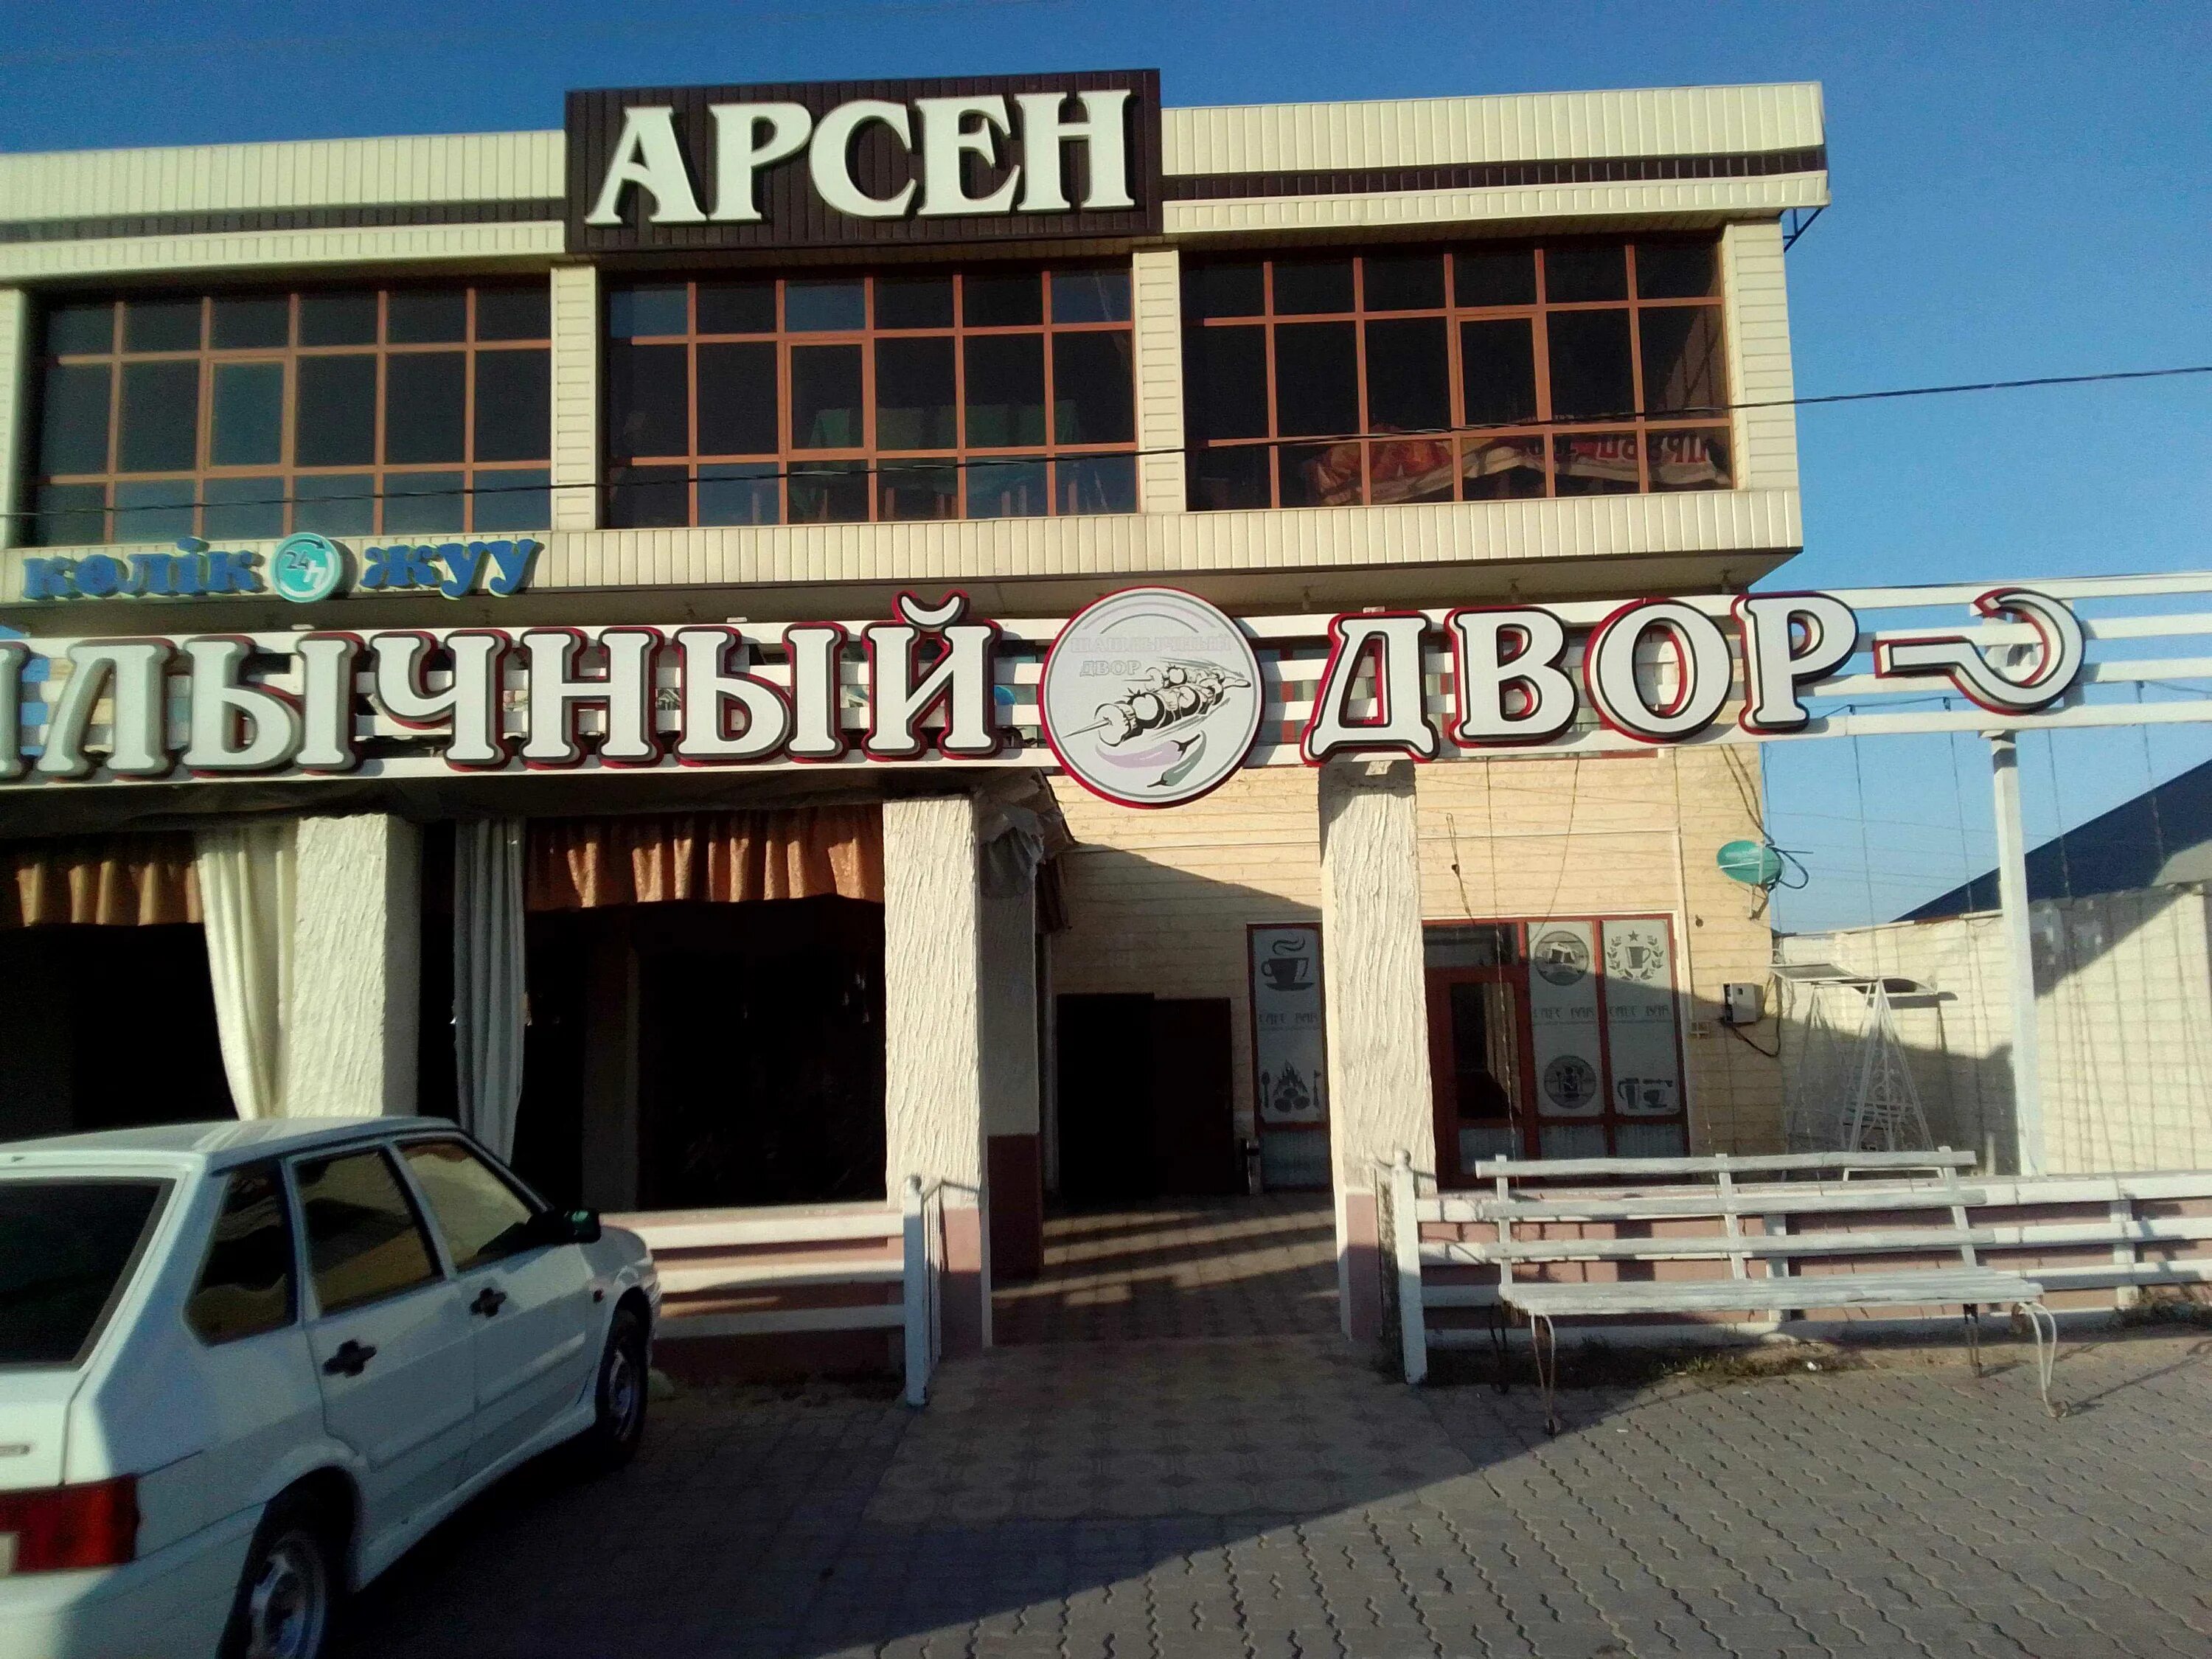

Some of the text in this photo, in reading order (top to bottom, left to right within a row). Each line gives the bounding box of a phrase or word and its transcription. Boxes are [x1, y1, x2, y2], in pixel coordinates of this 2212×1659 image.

[585, 88, 1136, 226] АРСЕН
[0, 589, 1859, 780] ЛЫЧНЫЙ ДВОР
[1079, 660, 1142, 678] ДВОР
